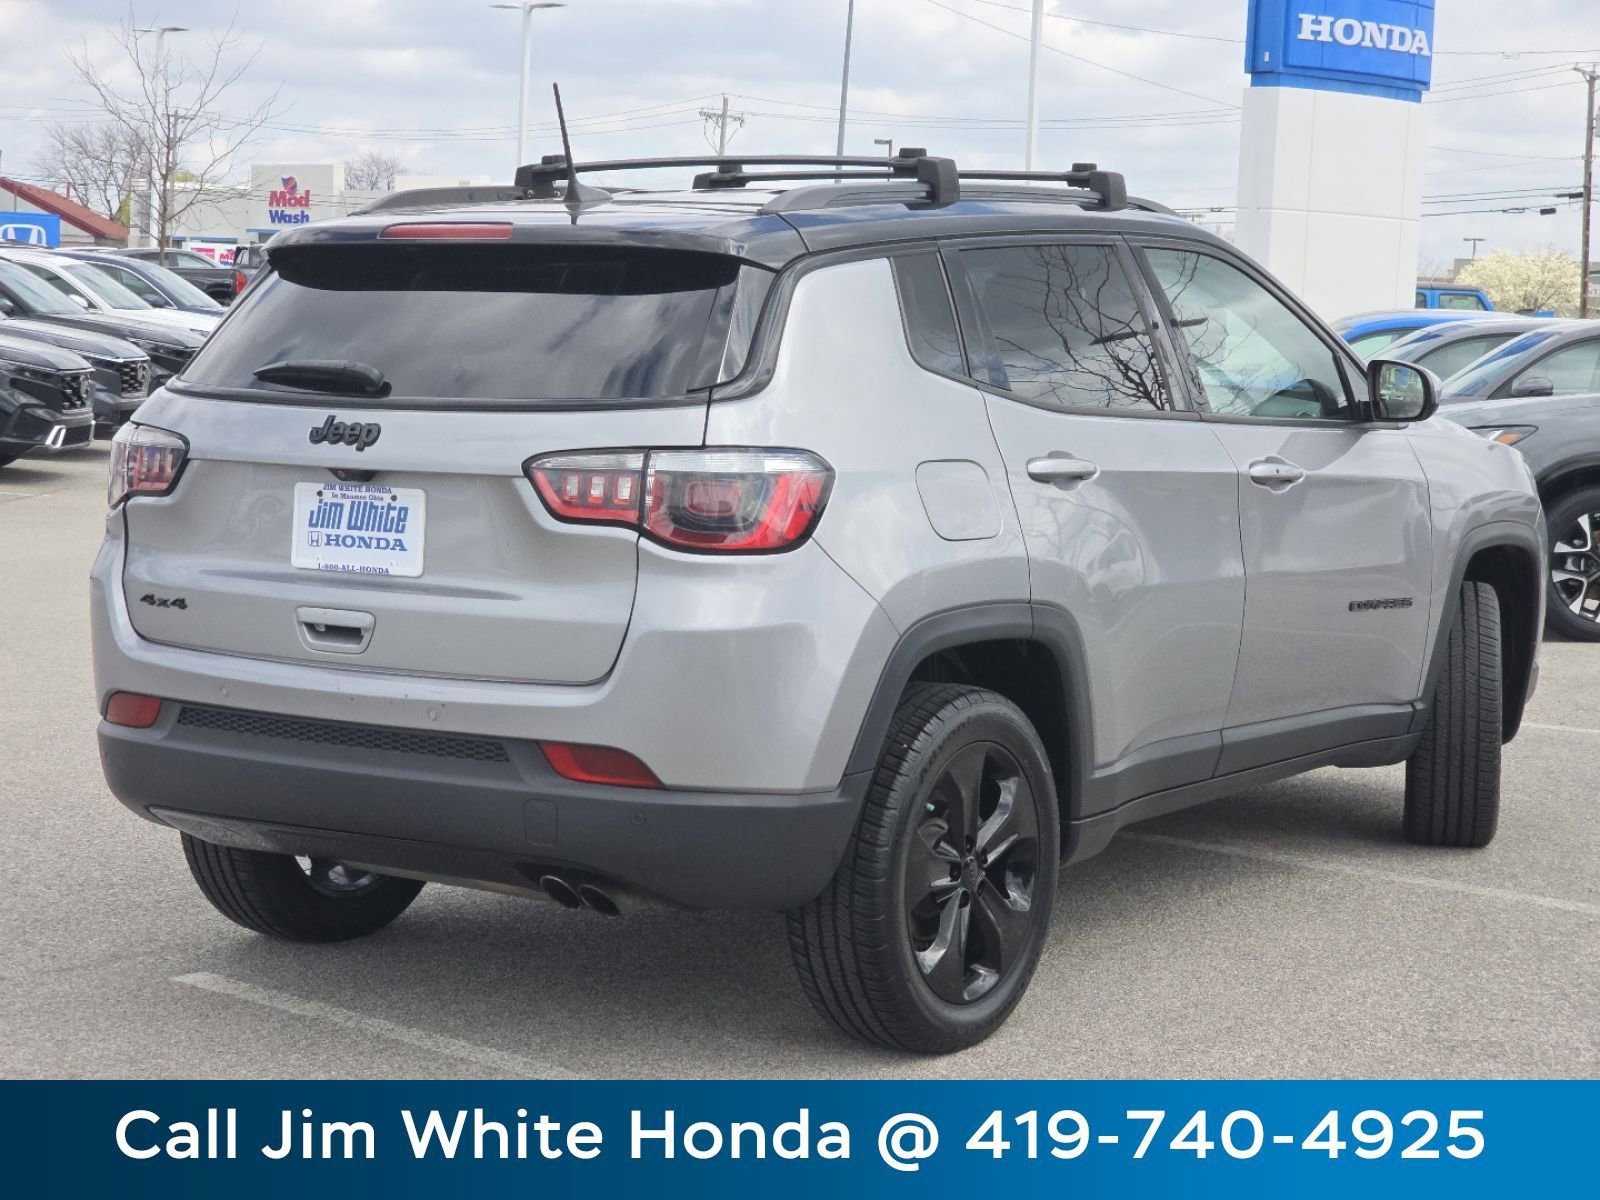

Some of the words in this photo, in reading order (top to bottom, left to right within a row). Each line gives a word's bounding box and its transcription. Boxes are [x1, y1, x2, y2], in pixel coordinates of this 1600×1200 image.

[1297, 13, 1432, 57] HONDA
[269, 190, 310, 207] Mod
[268, 209, 310, 224] Wash
[309, 414, 381, 452] Jeep
[339, 484, 363, 493] WHITE
[365, 486, 392, 495] HONDA
[340, 492, 367, 501] Maumee
[368, 494, 384, 502] Ohio
[347, 500, 409, 533] White
[324, 534, 408, 552] HONDA
[318, 562, 390, 575] 1-800-ALL-HONDA
